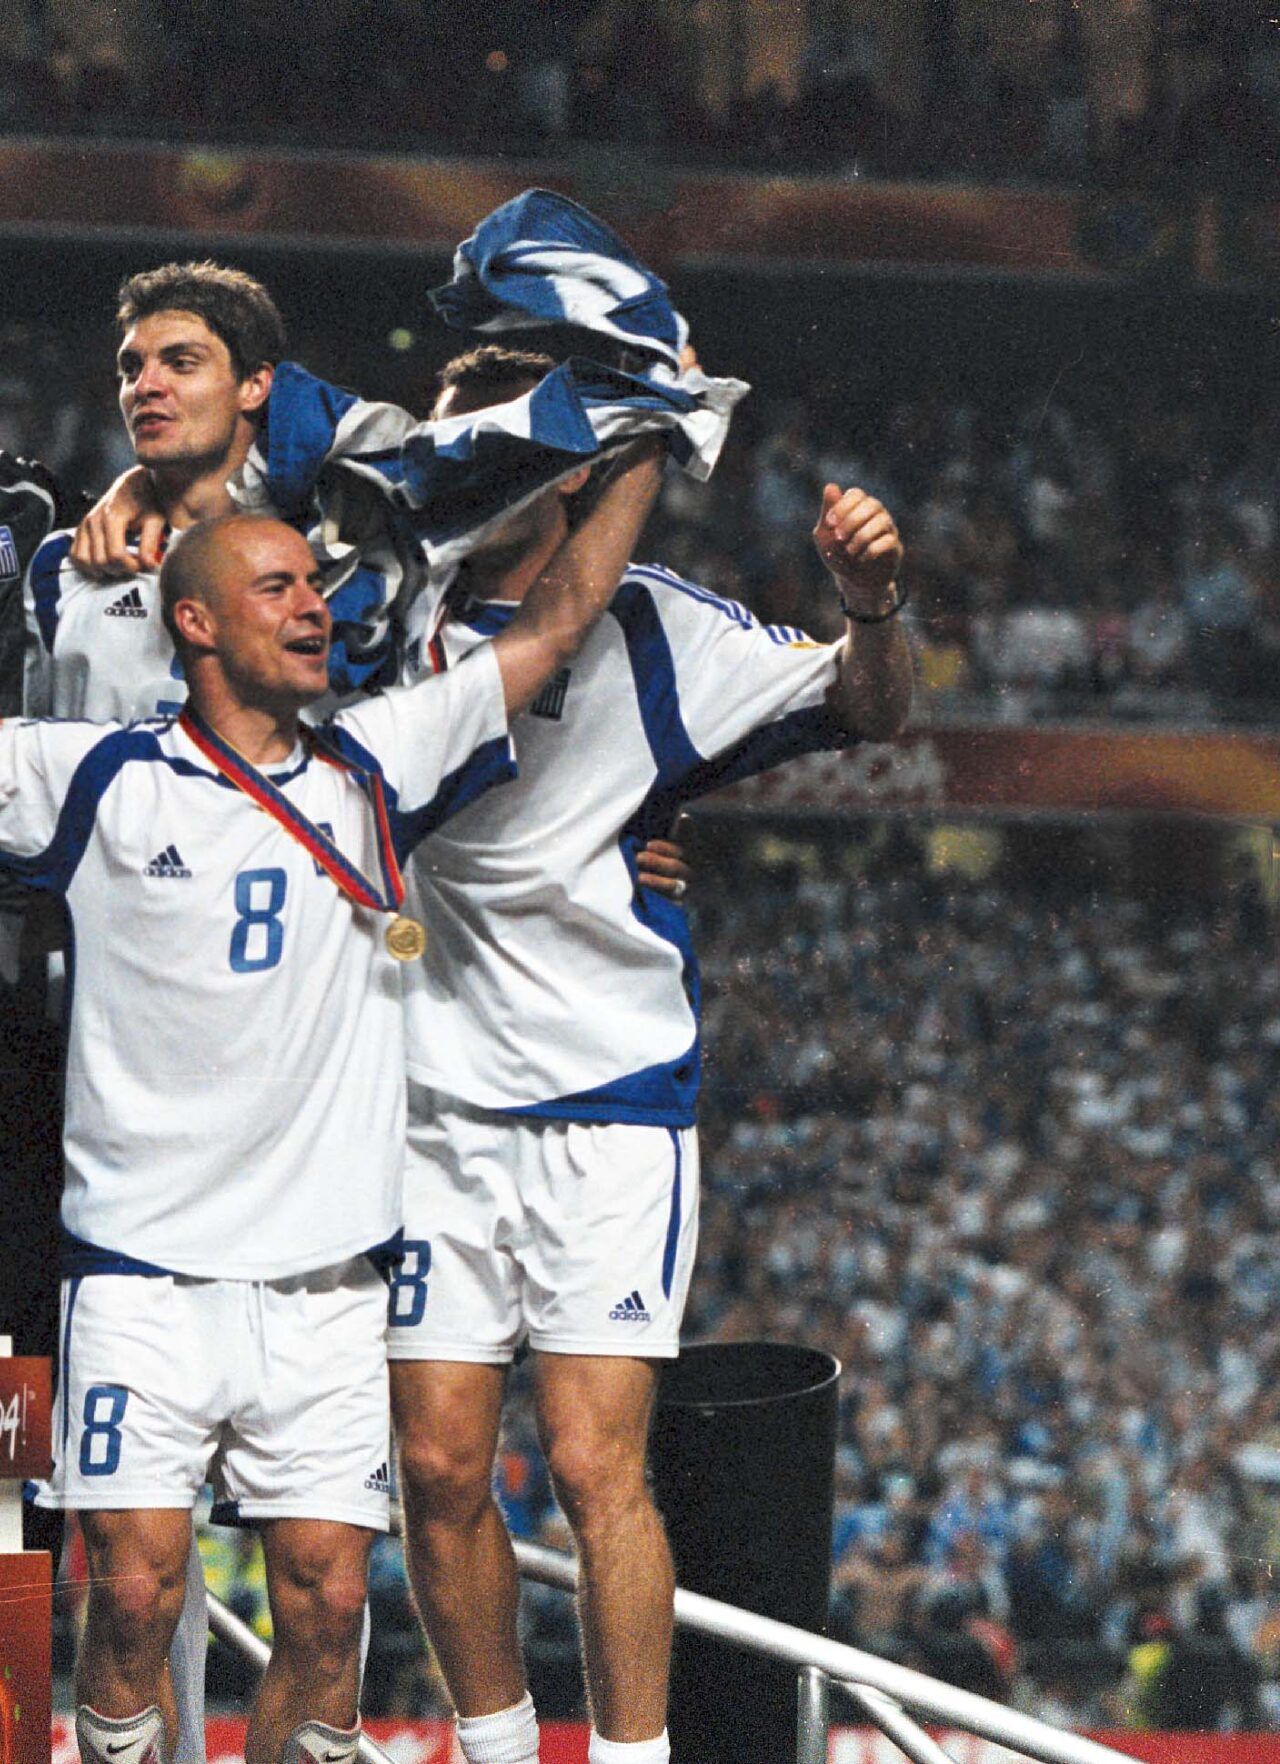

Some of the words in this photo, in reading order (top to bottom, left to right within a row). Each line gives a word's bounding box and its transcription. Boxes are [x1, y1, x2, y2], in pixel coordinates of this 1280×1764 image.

[142, 865, 193, 879] adidas
[228, 866, 288, 974] 8
[608, 1309, 651, 1323] adidas
[78, 1386, 129, 1476] 8
